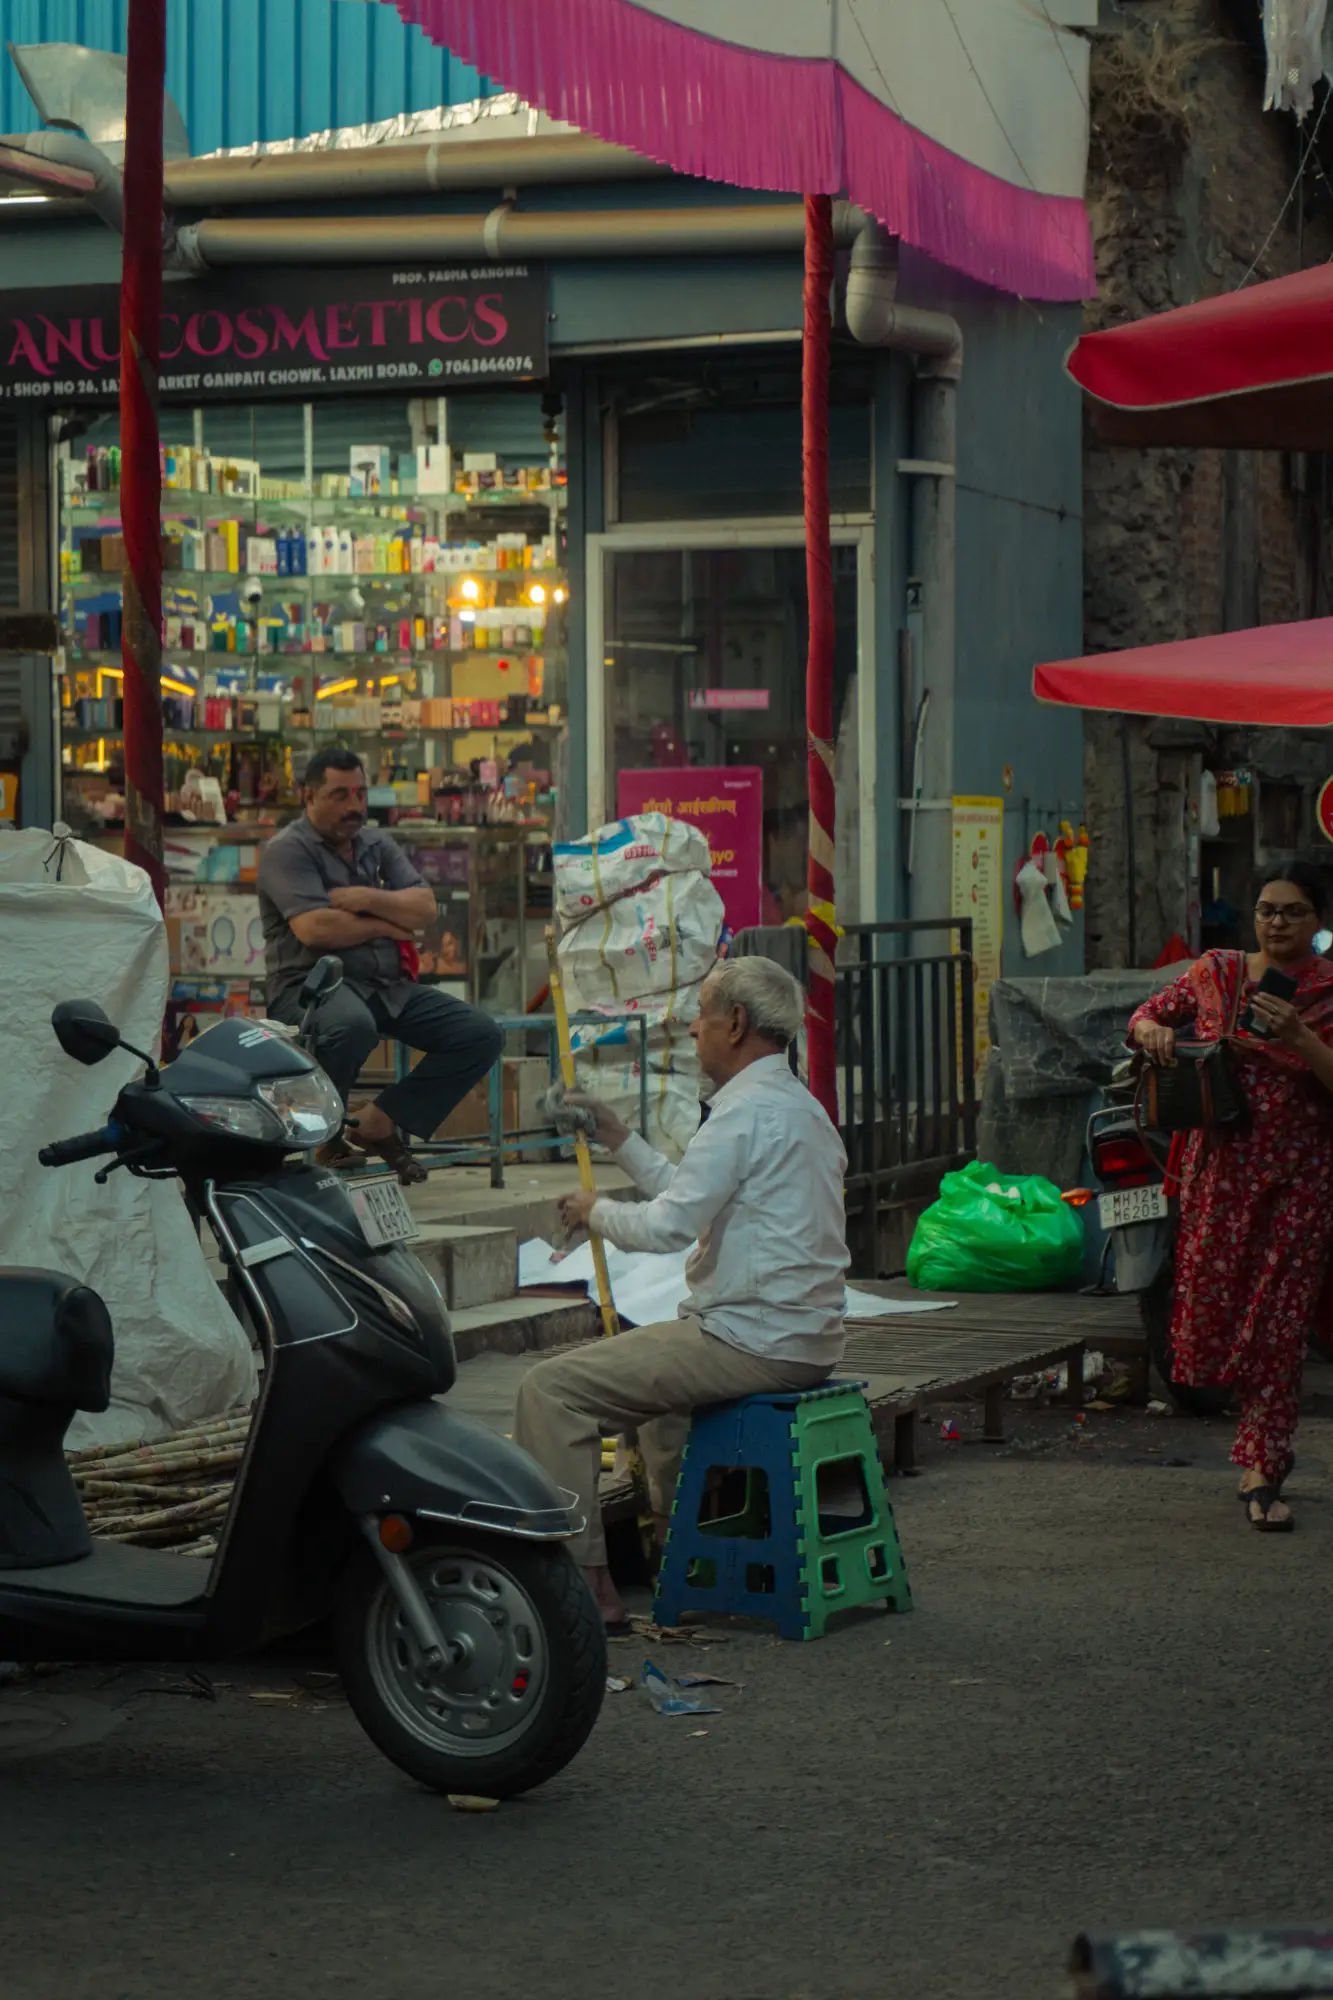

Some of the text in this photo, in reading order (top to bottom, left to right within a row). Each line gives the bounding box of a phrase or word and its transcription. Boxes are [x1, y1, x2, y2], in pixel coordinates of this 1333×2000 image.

[8, 293, 508, 377] ANU COSMETICS
[13, 381, 52, 397] SHOP
[53, 380, 75, 396] NO
[101, 378, 120, 393] LA
[158, 373, 201, 391] ARKET
[202, 370, 266, 388] GANPATI
[329, 364, 373, 381] LAXMI
